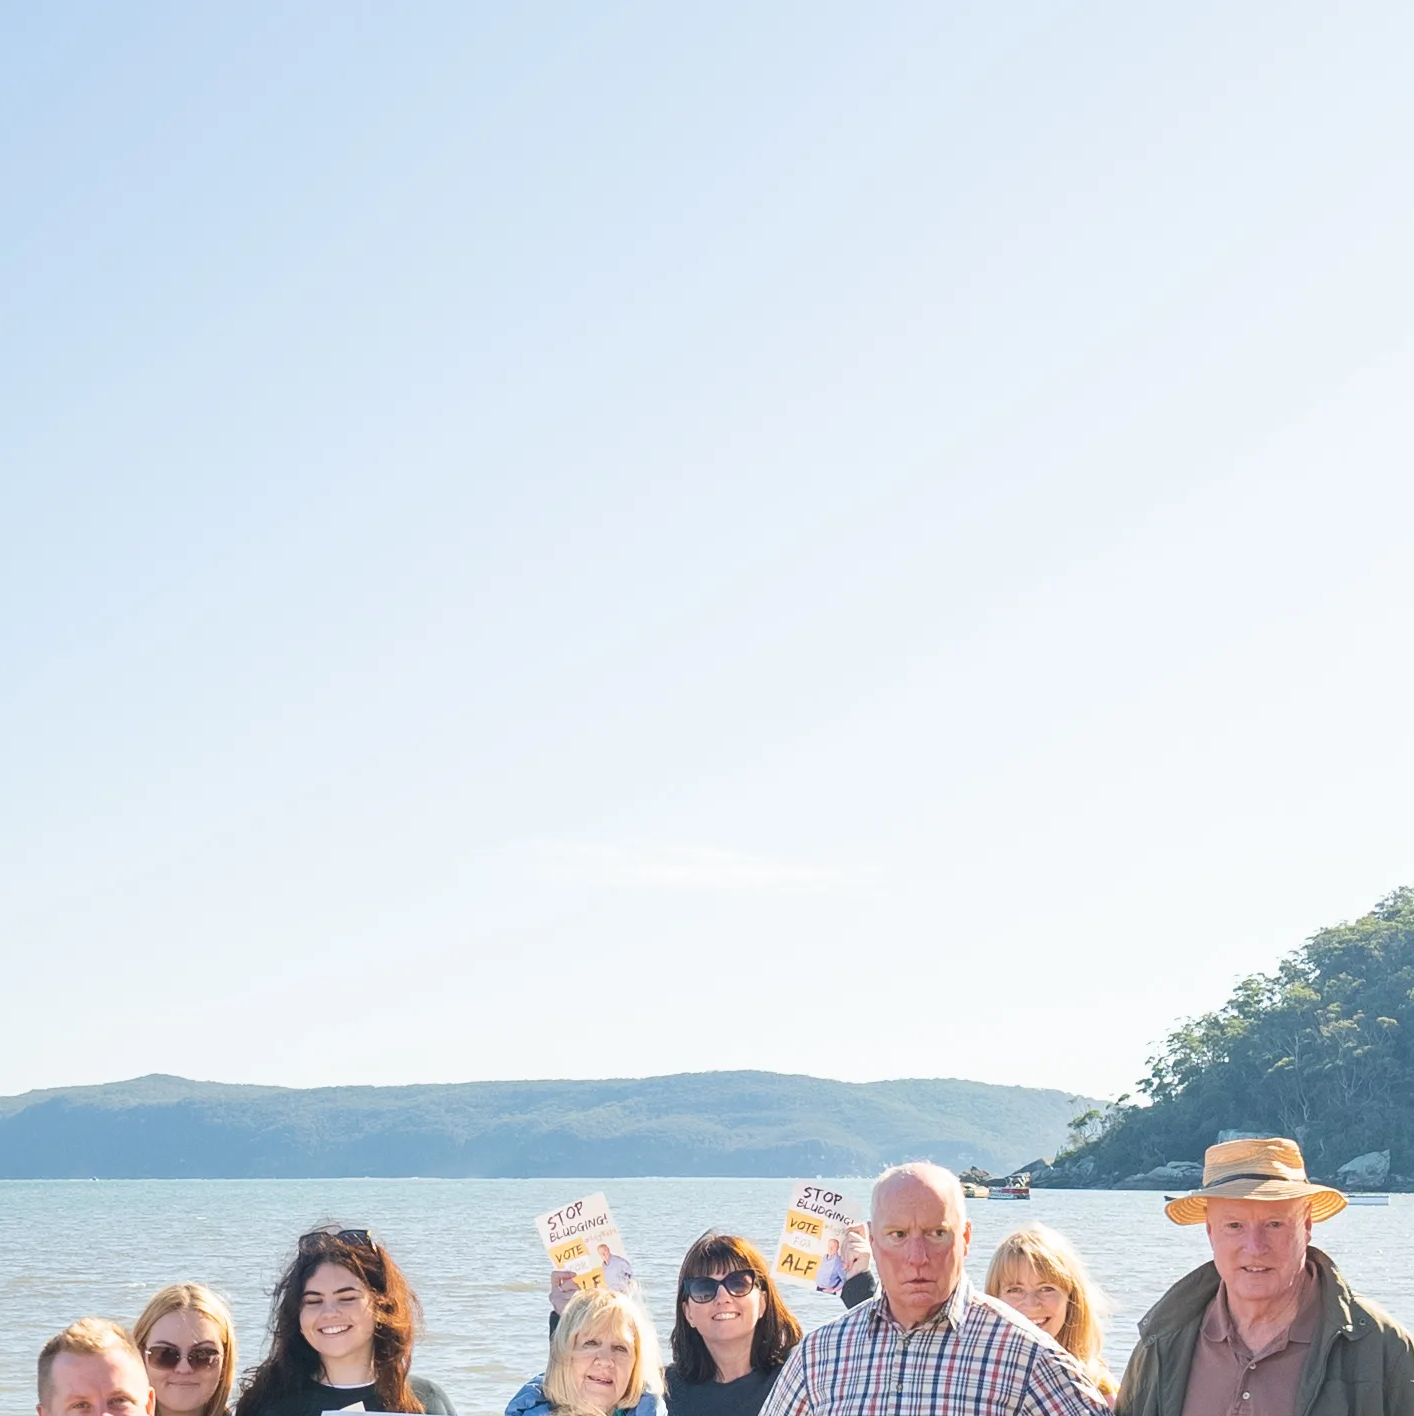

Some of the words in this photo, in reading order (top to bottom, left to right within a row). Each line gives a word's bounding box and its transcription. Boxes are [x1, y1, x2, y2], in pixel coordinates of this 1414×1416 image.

[803, 1186, 843, 1206] STOP
[547, 1201, 583, 1231] STOP
[790, 1217, 820, 1235] VOTE
[549, 1213, 609, 1243] BLUDGING!
[555, 1244, 584, 1263] VOTE
[781, 1253, 818, 1276] ALF
